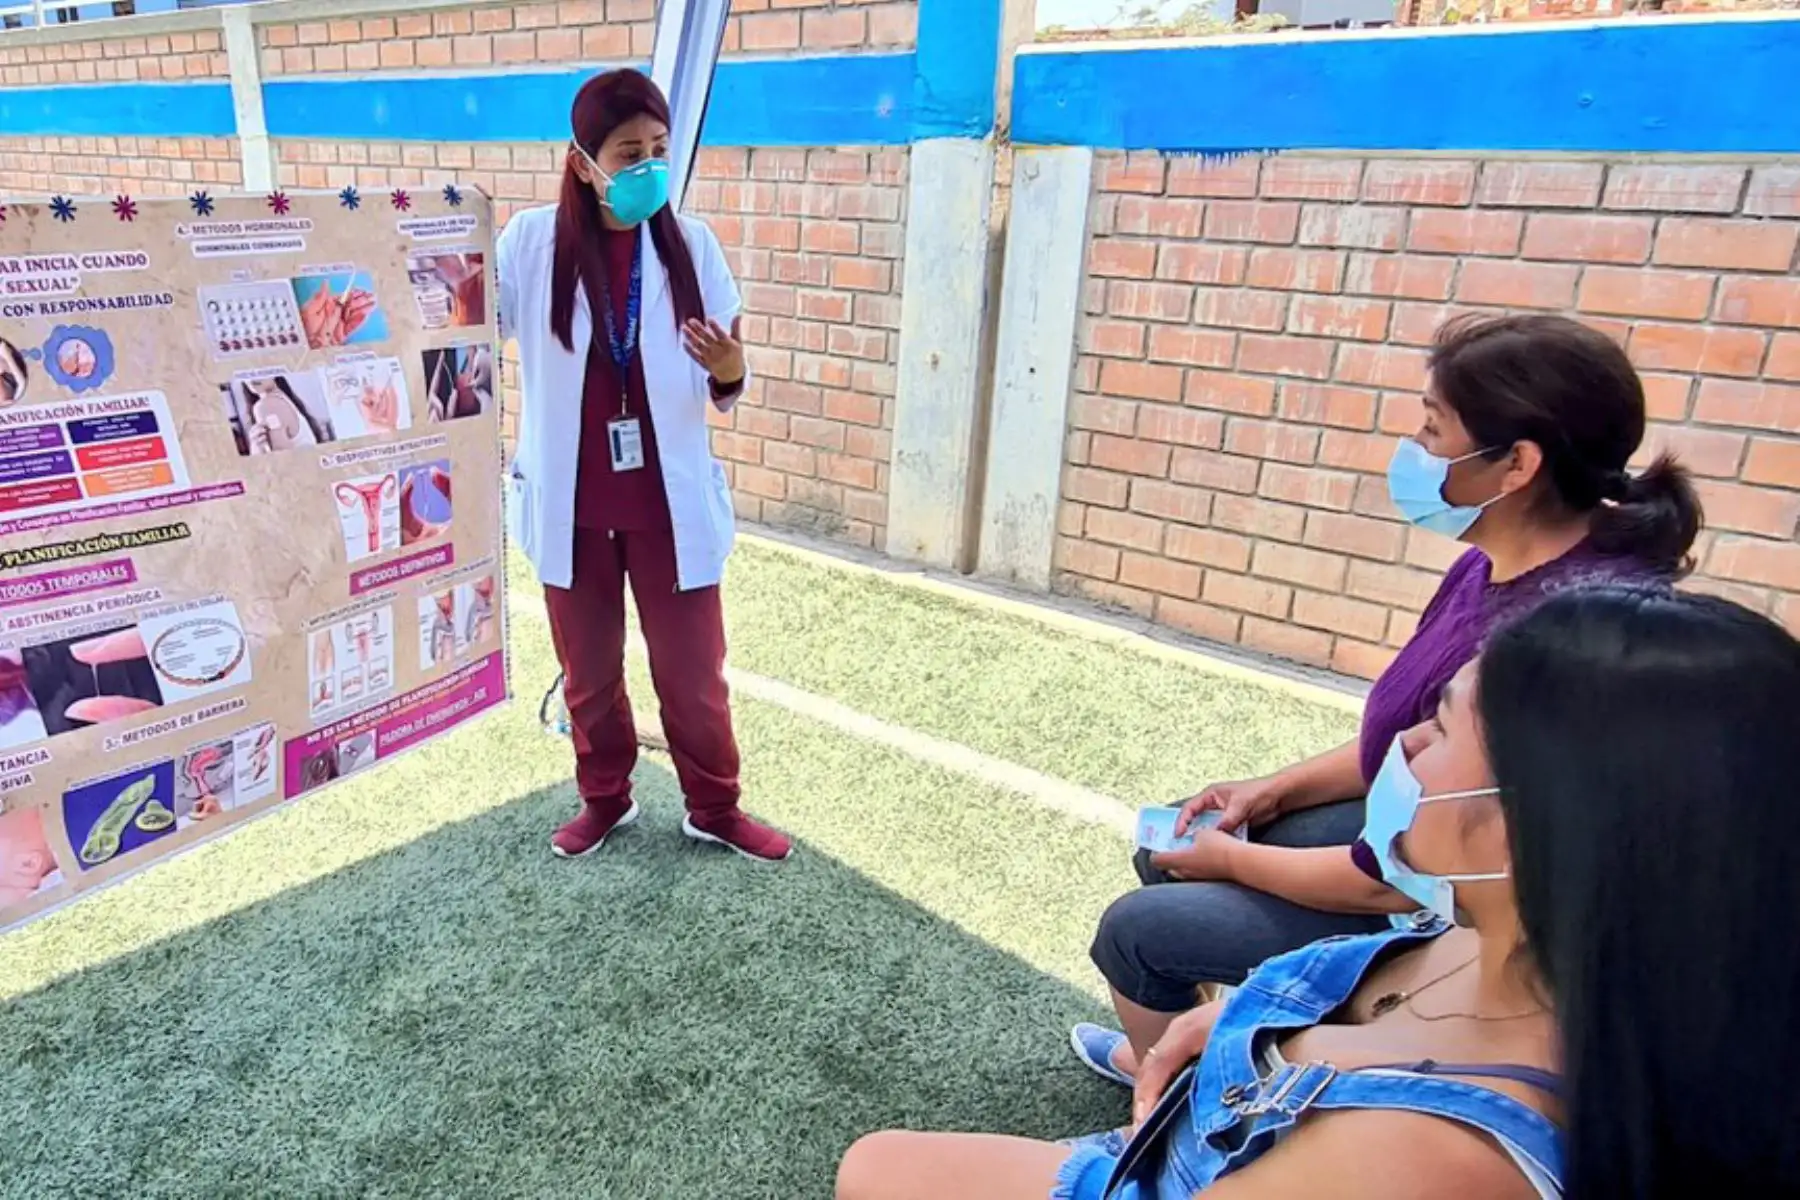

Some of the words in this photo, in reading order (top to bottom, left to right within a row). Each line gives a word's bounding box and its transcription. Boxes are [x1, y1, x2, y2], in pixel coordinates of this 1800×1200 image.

[192, 223, 242, 235] METODOS
[244, 219, 312, 231] HORMONALES
[24, 256, 79, 273] INICIA
[82, 252, 146, 269] CUANDO
[3, 303, 34, 317] CON
[39, 292, 173, 315] RESPONSABILIDAD
[4, 532, 120, 567] PLANIFICACIÓN
[121, 524, 188, 546] FAMILIAR
[47, 564, 128, 592] TEMPORALES
[8, 603, 94, 629] ABSTINENCIA
[97, 590, 161, 611] PERIÓDICA
[122, 720, 177, 743] METODOS
[180, 713, 194, 726] DE
[197, 698, 245, 720] BARRERA
[0, 750, 49, 772] TANCIA
[1, 774, 32, 790] SIVA
